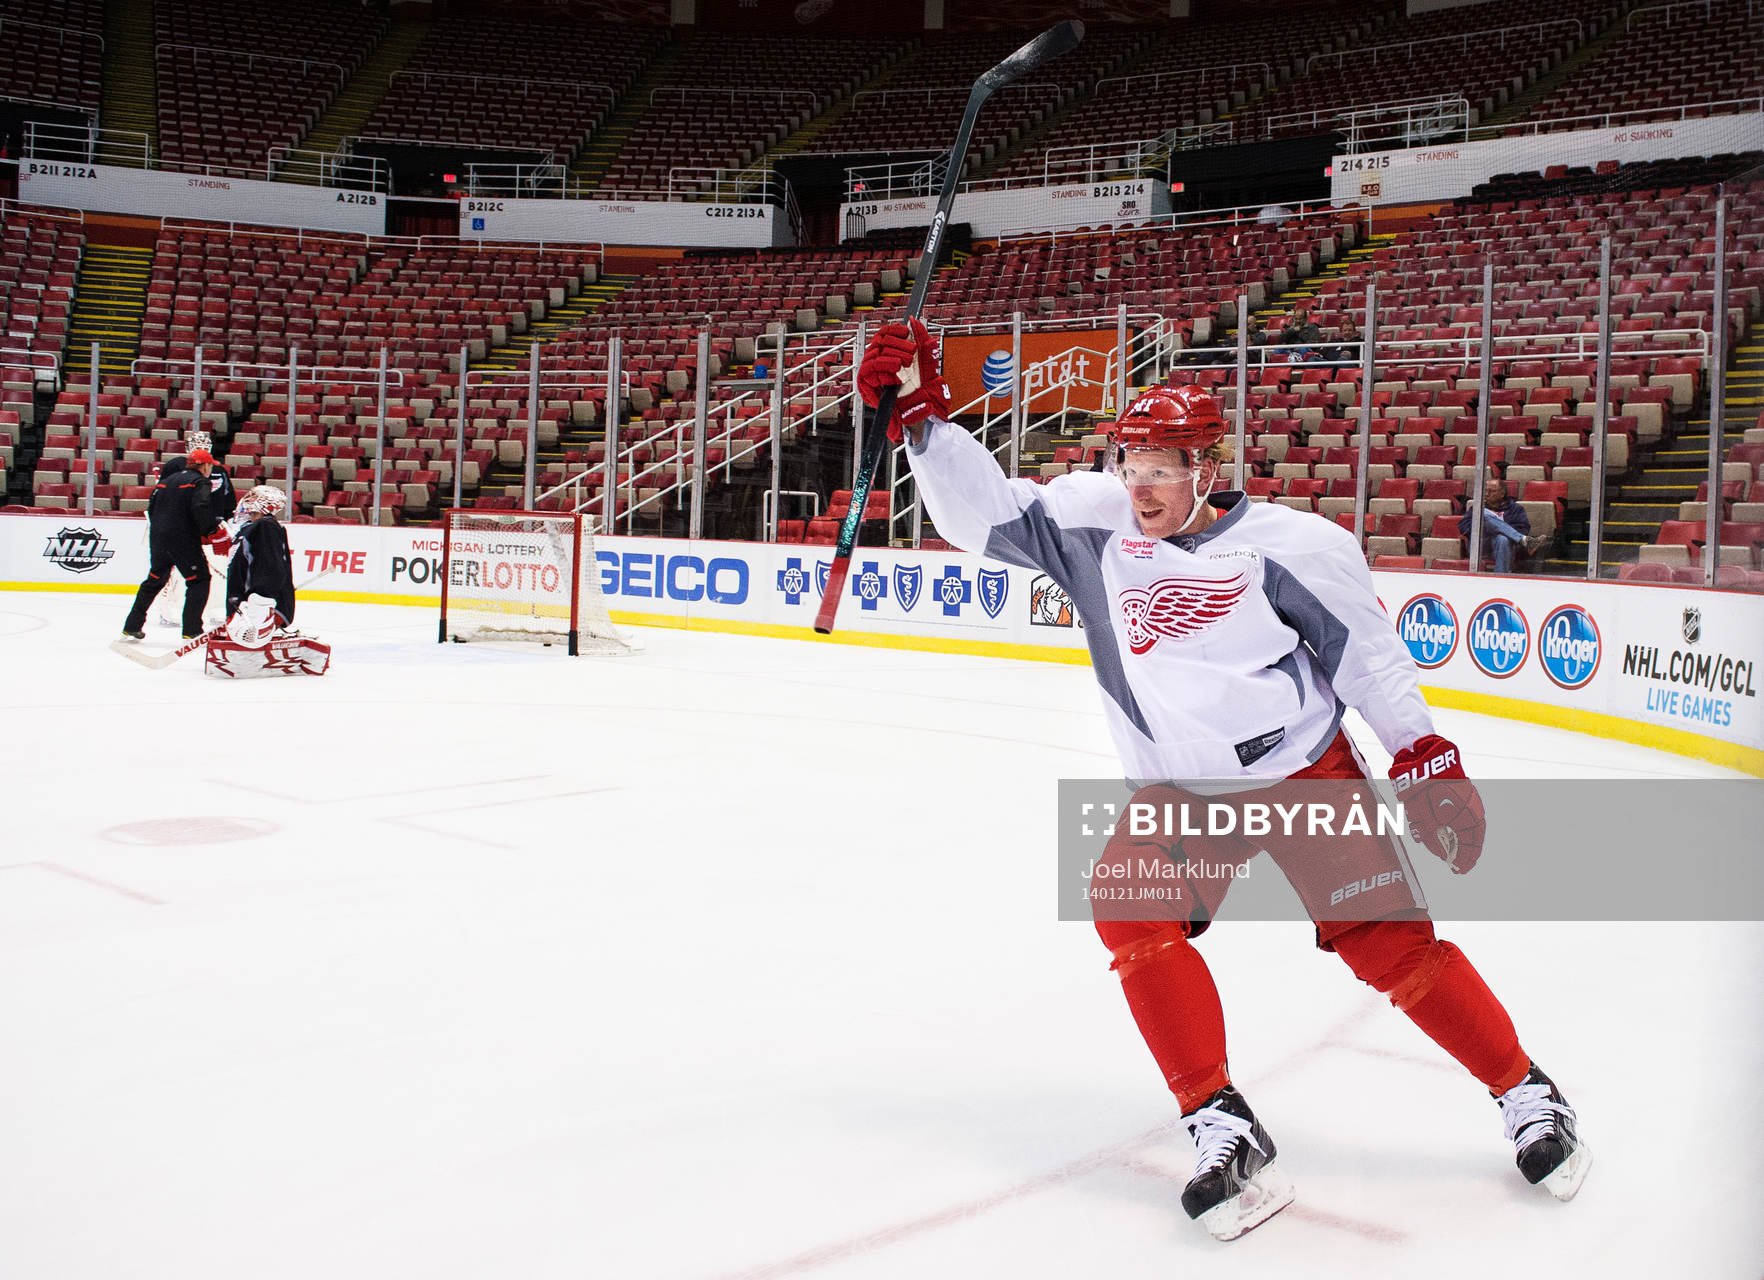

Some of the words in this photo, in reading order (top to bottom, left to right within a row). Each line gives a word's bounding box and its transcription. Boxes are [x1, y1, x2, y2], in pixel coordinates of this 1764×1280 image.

[1416, 150, 1459, 162] STANDING
[1341, 160, 1363, 172] 214
[1367, 156, 1390, 170] 215
[63, 166, 97, 179] 212A
[188, 178, 231, 190] STANDING
[1094, 185, 1120, 198] B213
[1124, 184, 1144, 195] 214
[336, 193, 377, 206] A212B
[1052, 189, 1087, 199] STANDING
[468, 202, 504, 212] B212C
[895, 201, 926, 211] STANDING
[1122, 200, 1136, 209] SRO
[1029, 355, 1090, 388] at&t
[1121, 426, 1151, 435] BAUER
[43, 537, 115, 558] NHL
[488, 543, 545, 556] LOTTERY
[1121, 539, 1157, 549] Flagstar
[304, 550, 367, 574] TIRE
[595, 550, 750, 605] GEICO
[1403, 603, 1456, 661] Kroger
[1475, 609, 1526, 669] Kroger
[1546, 615, 1598, 680] Kroger
[1623, 644, 1756, 697] NHL.COM/GCL
[1647, 687, 1680, 715] LIVE
[1682, 693, 1732, 727] GAMES
[1330, 870, 1403, 906] BAUER
